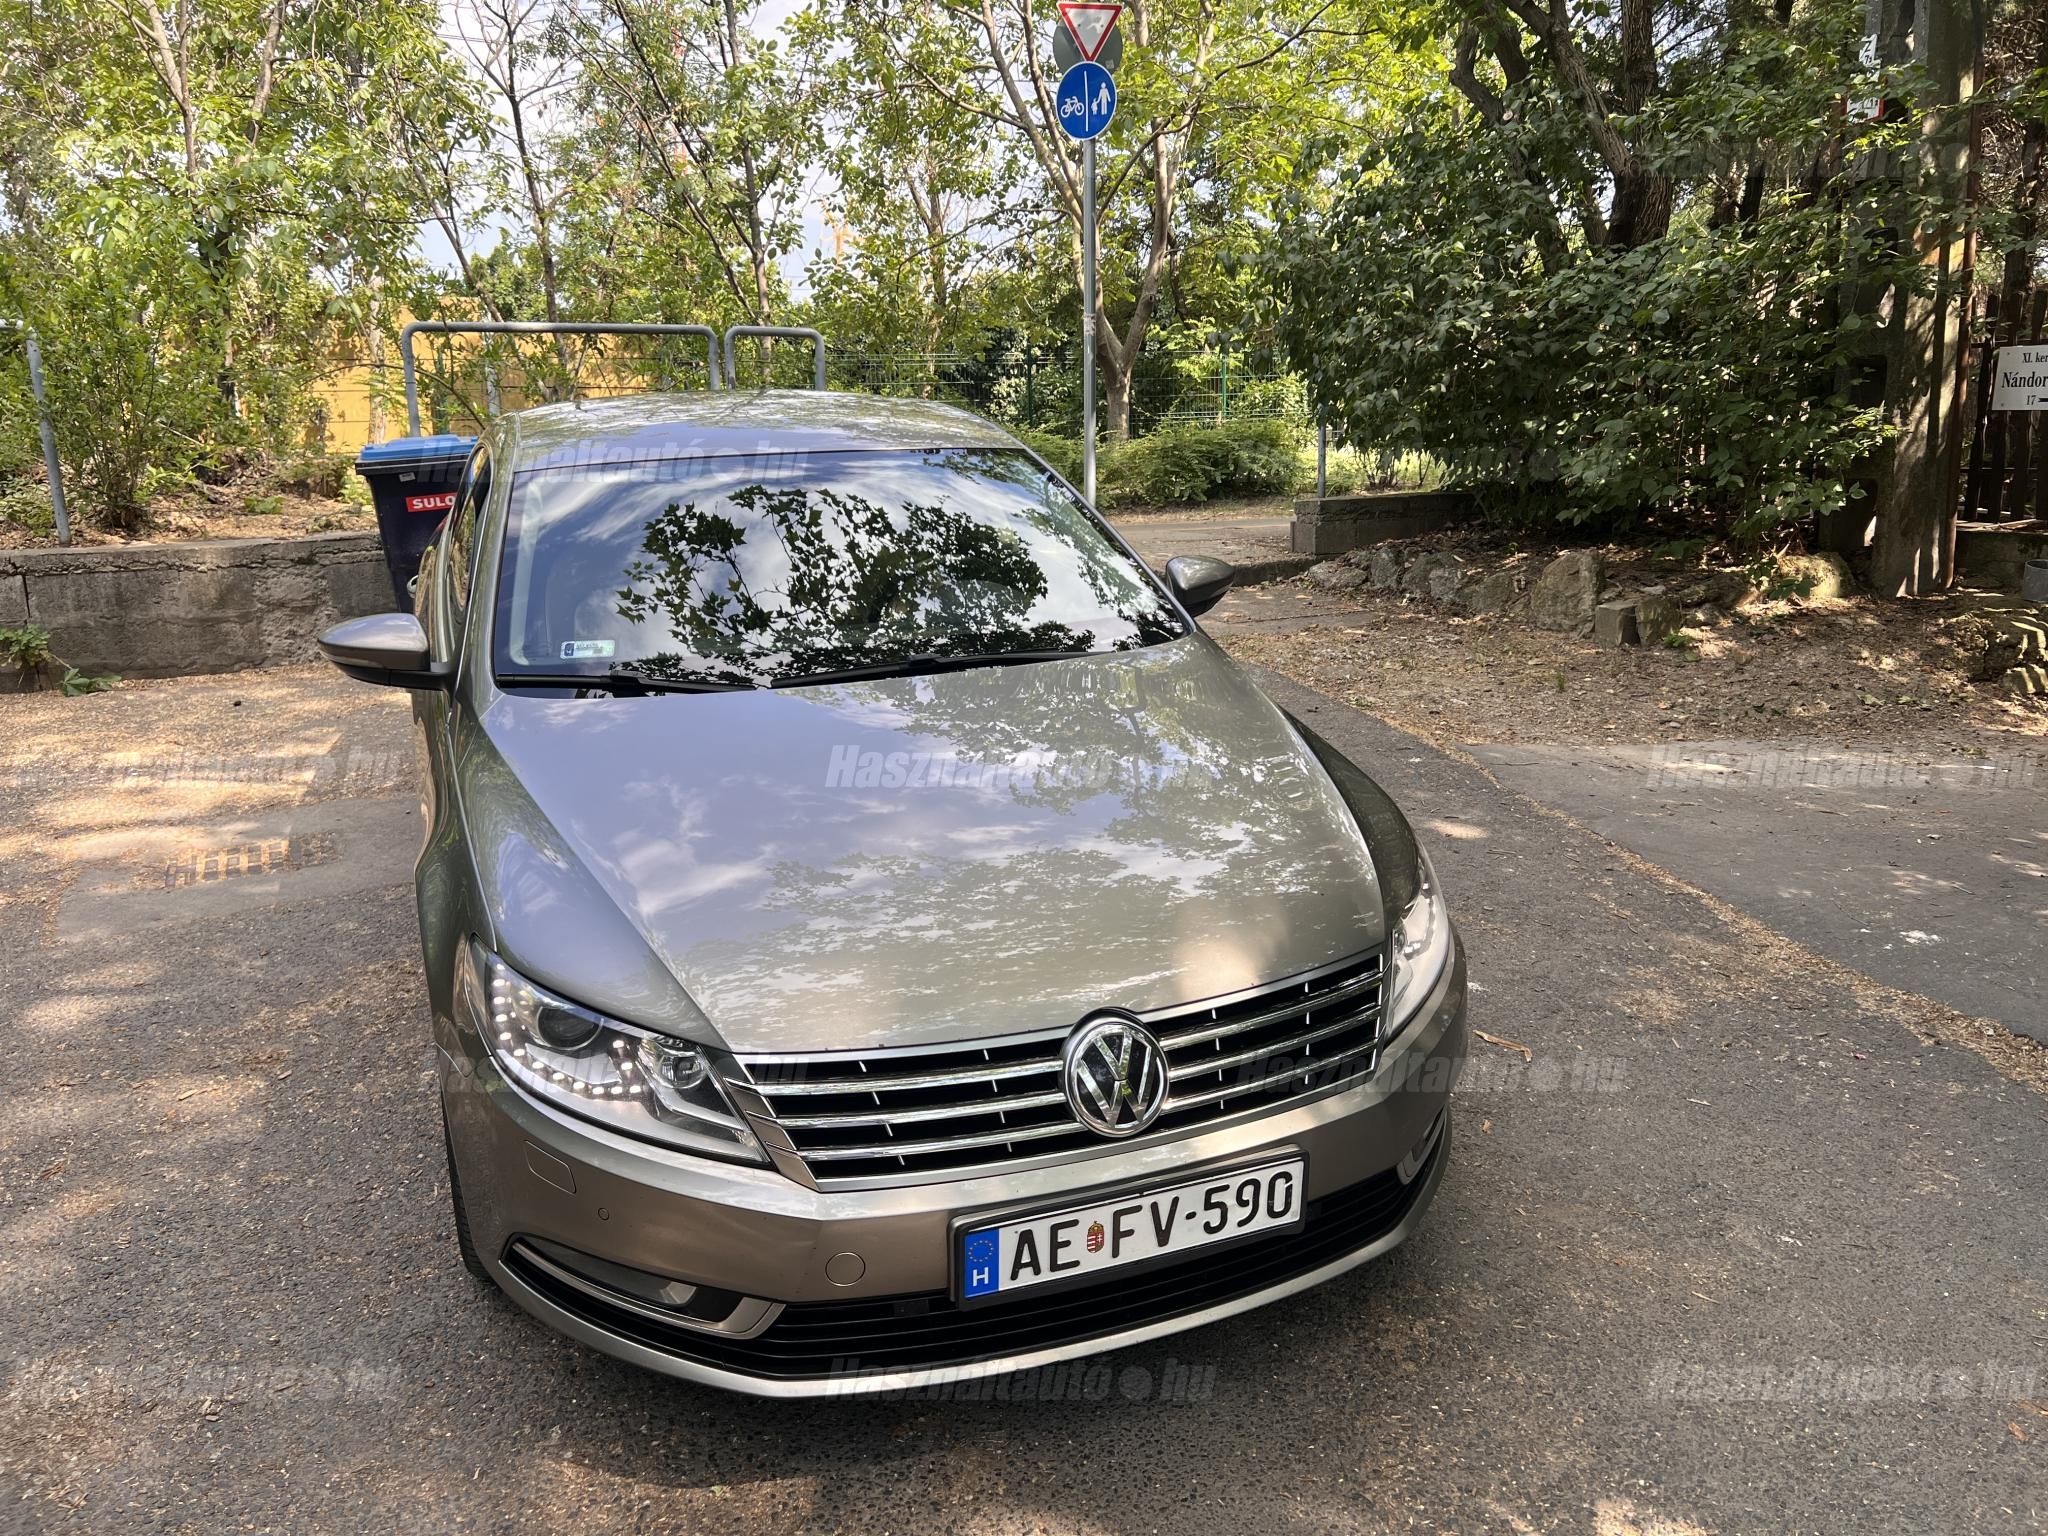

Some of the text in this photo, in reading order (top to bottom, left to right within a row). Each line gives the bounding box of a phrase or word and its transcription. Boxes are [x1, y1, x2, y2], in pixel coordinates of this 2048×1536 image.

[2002, 371, 2048, 388] Nándor
[2026, 395, 2037, 405] 17
[412, 495, 457, 509] SULO
[1010, 1170, 1293, 1280] AE FV-590
[972, 1267, 989, 1287] H
